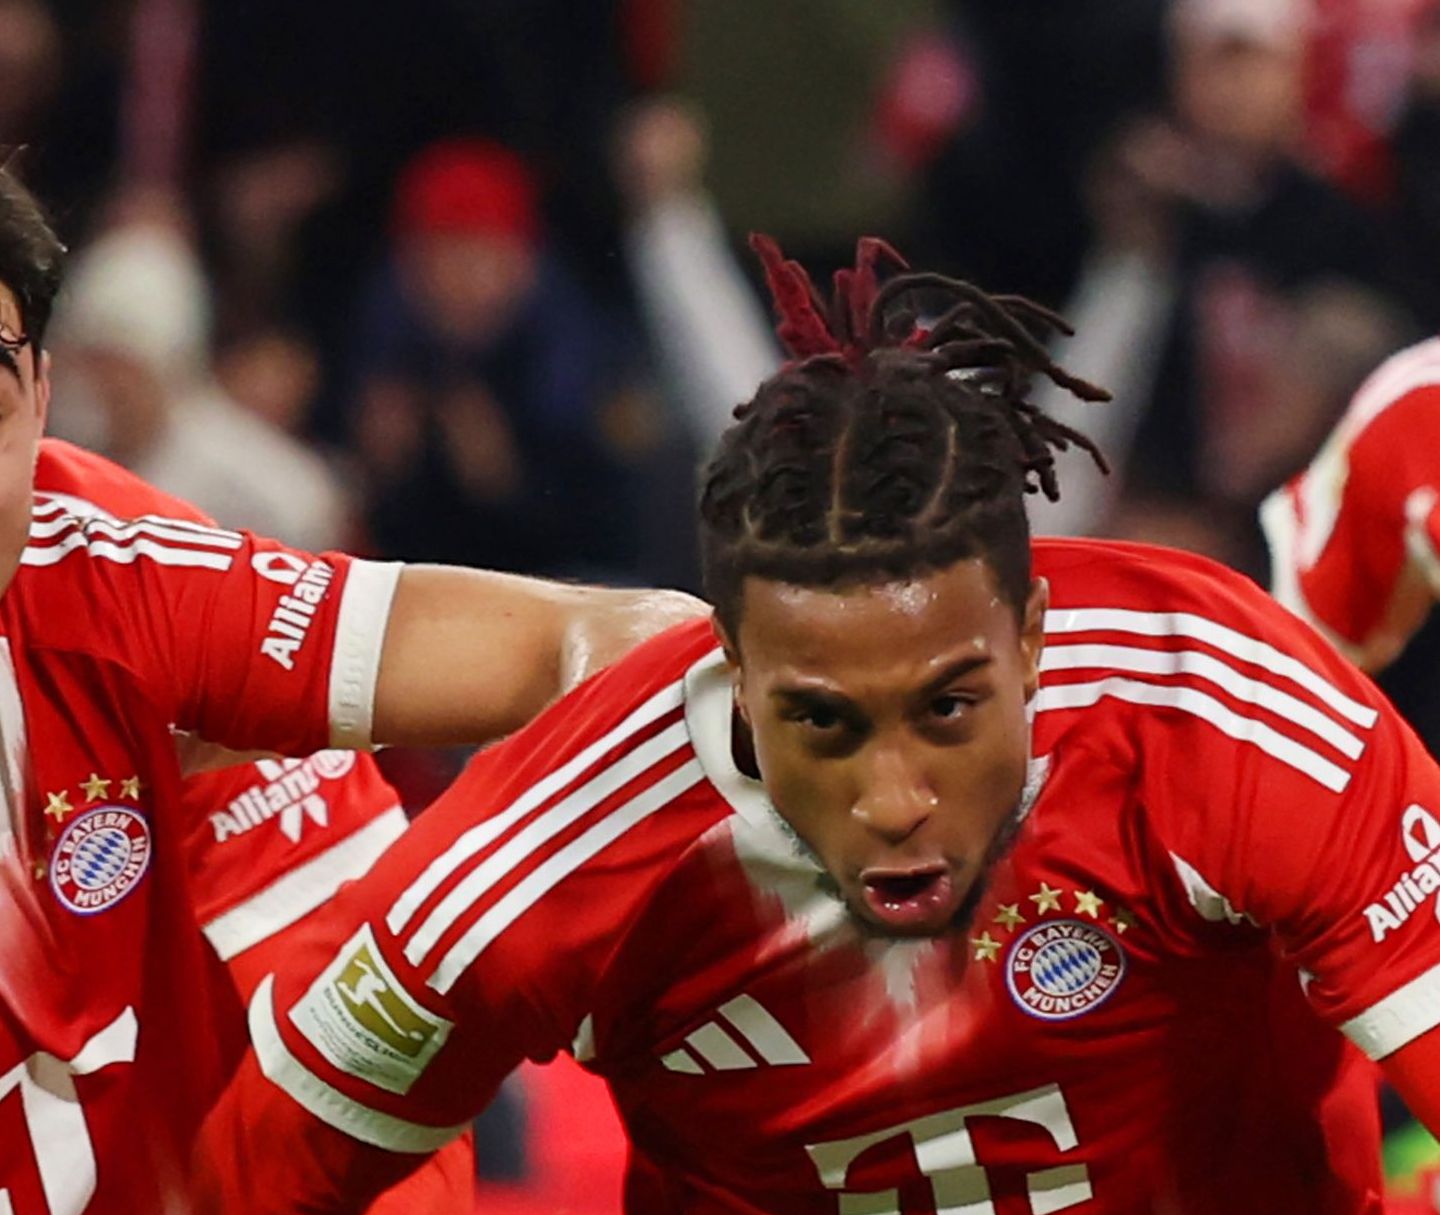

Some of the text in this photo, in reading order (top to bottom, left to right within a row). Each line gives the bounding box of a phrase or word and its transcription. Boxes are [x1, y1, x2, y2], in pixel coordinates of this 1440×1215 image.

[62, 813, 134, 853] BAYERN
[1014, 925, 1111, 973] FC BAYERN
